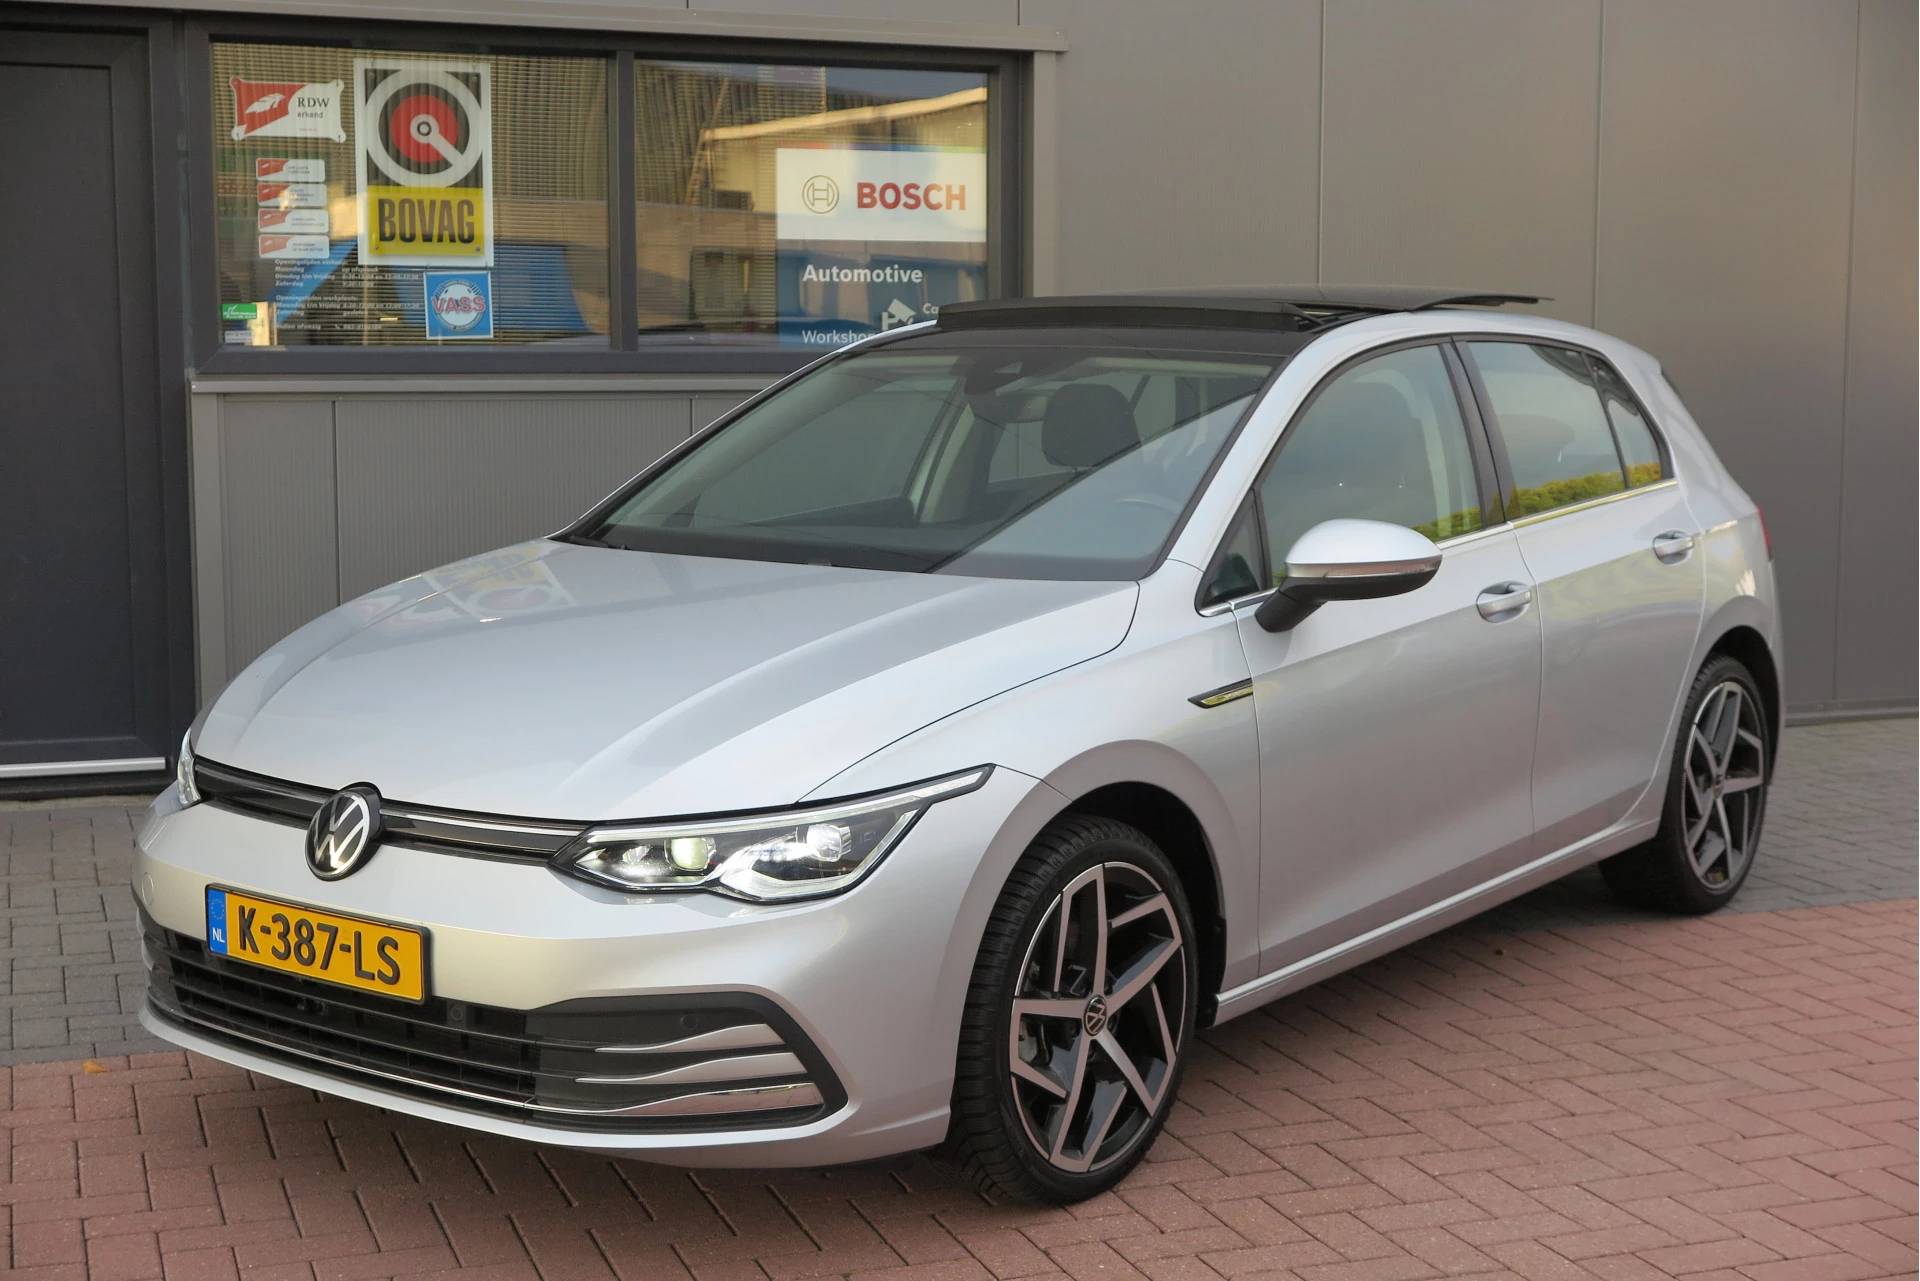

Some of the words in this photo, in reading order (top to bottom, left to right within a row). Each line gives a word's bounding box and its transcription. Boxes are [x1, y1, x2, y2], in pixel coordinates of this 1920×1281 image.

[297, 97, 330, 108] RDW
[857, 182, 967, 211] BOSCH
[378, 198, 475, 244] BOVAG
[803, 264, 924, 283] Automotive
[431, 295, 486, 313] VASS
[922, 303, 940, 314] Ca
[212, 927, 226, 944] NL
[238, 904, 401, 985] K-387-LS
